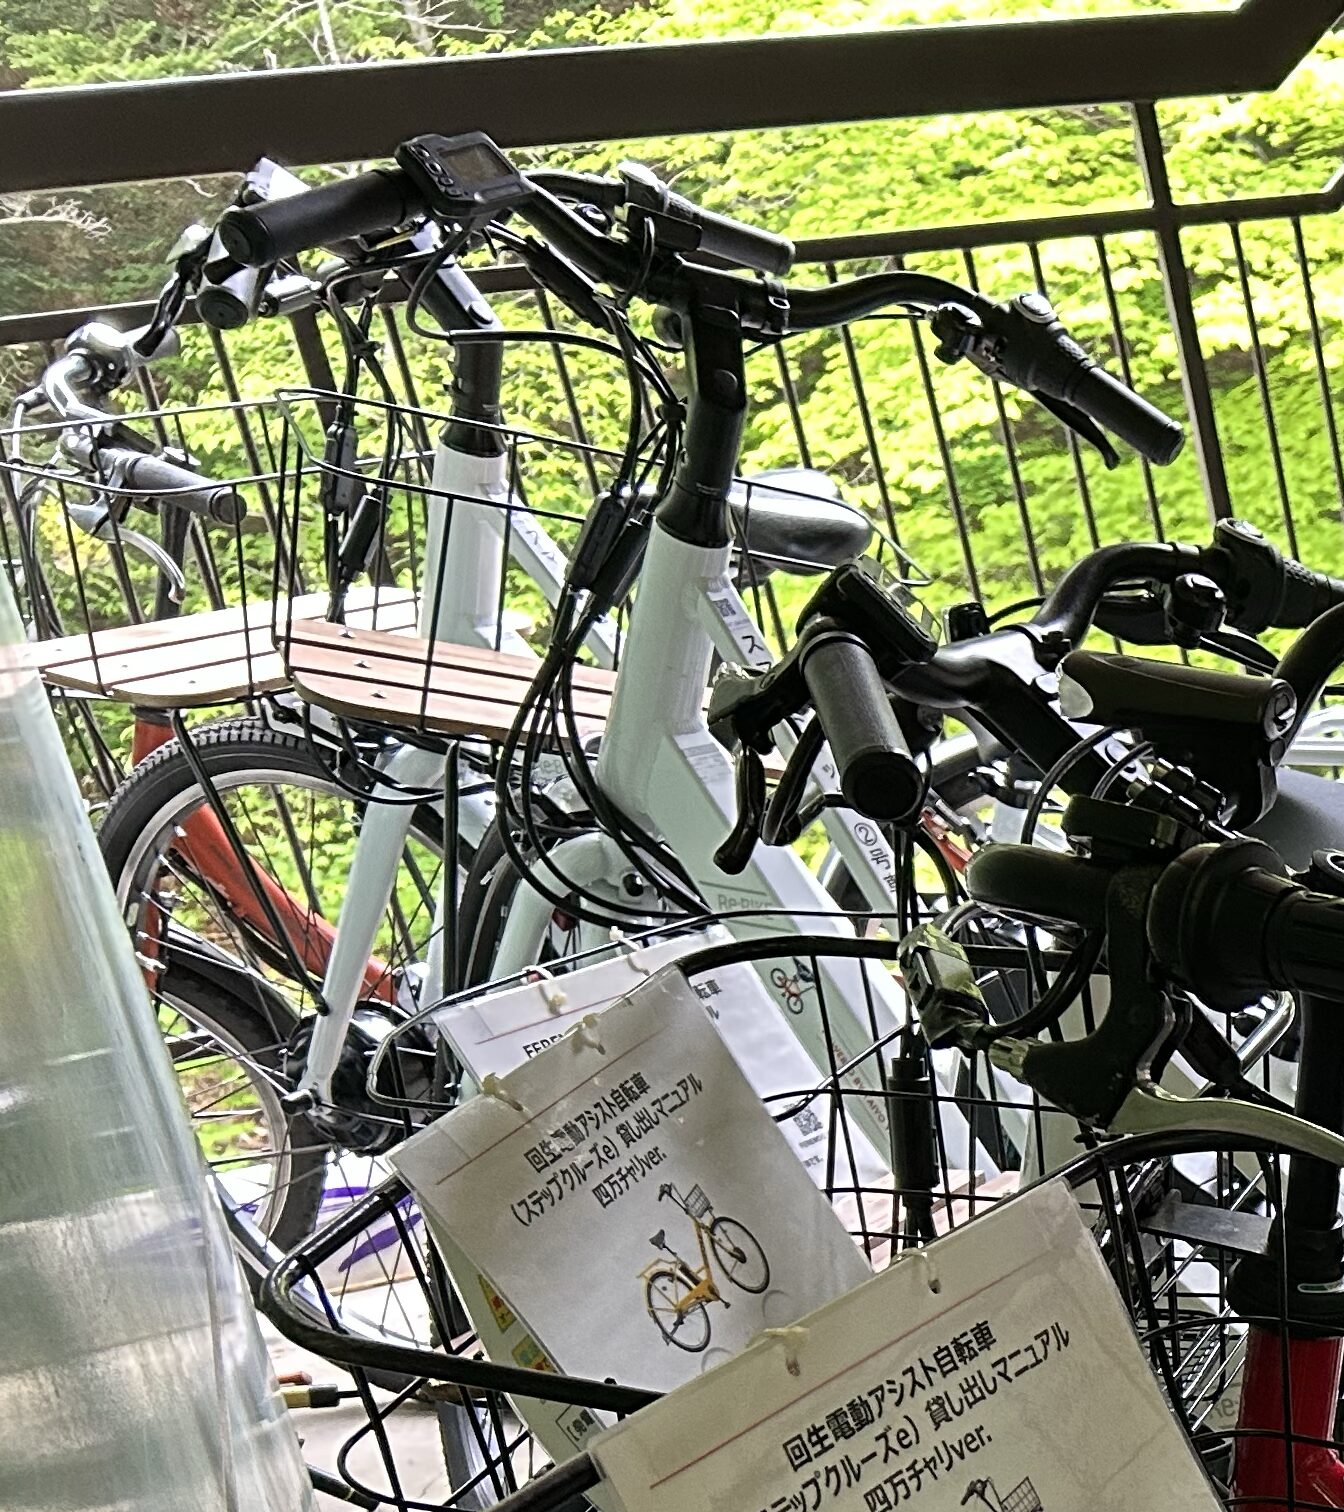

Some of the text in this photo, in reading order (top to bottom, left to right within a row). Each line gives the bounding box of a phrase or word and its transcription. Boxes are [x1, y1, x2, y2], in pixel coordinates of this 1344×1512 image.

[782, 1319, 997, 1472] 回生電動アシスト自転車
